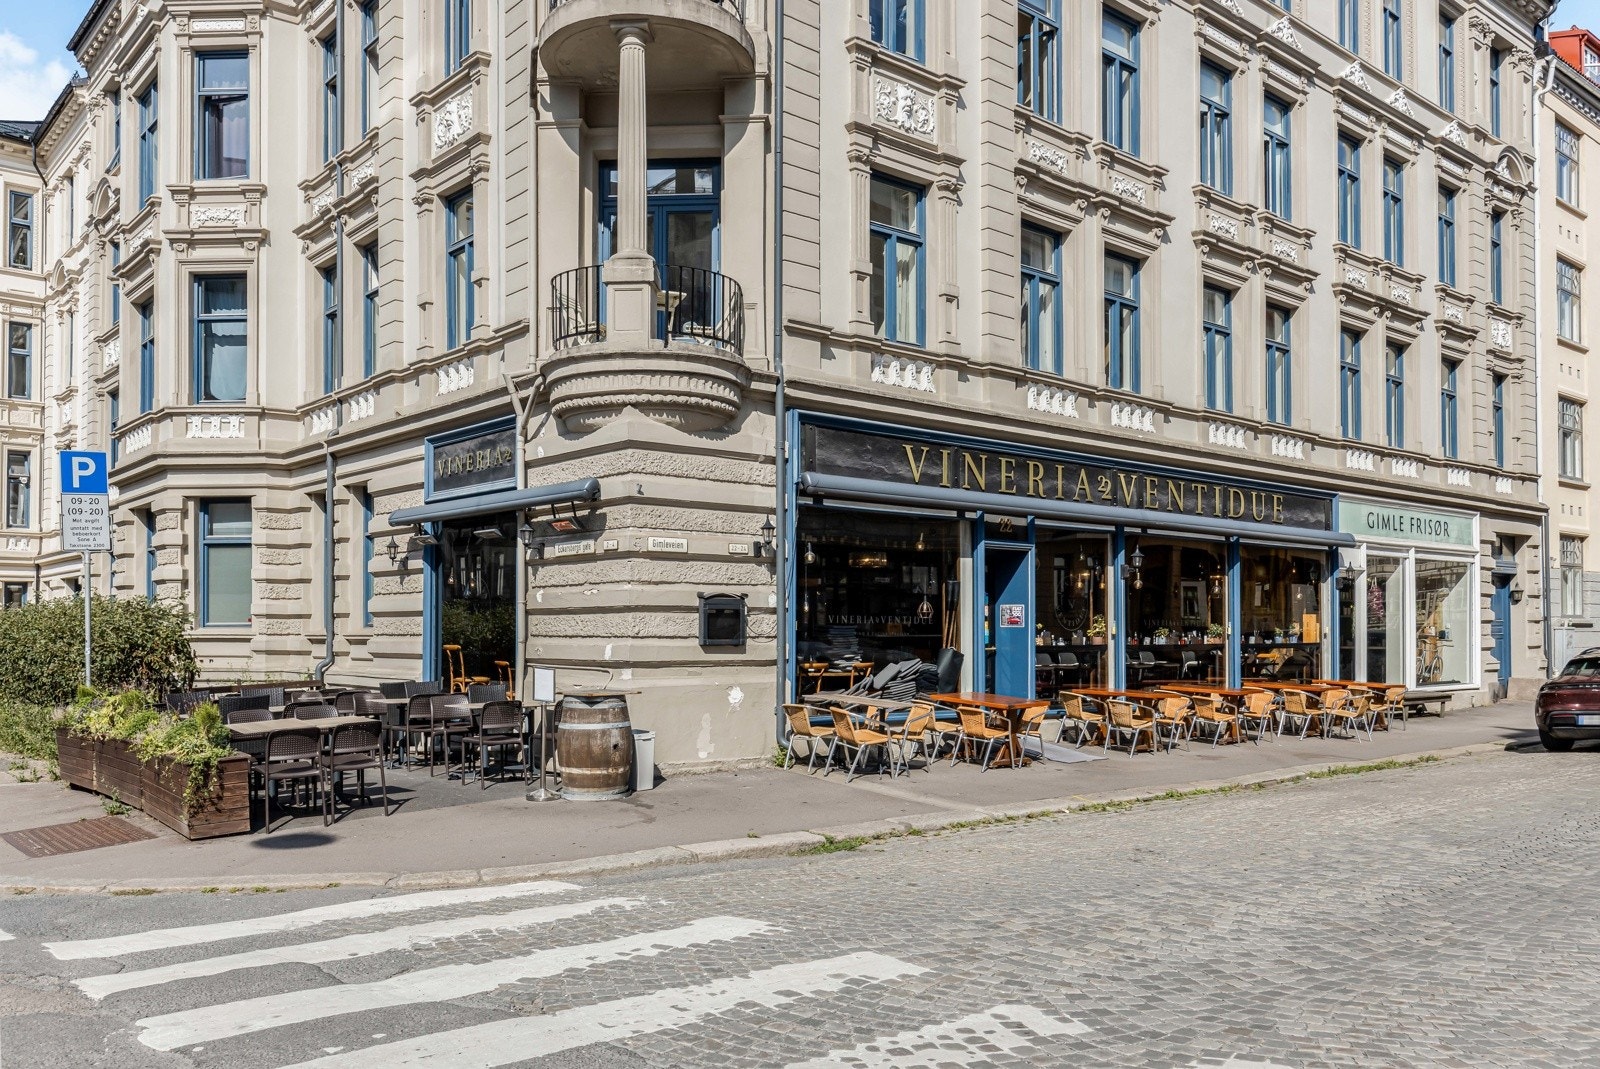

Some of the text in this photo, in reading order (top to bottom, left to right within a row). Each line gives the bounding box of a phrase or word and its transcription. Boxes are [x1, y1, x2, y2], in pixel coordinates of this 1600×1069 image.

[71, 456, 96, 488] P
[438, 446, 503, 477] VINERIA
[902, 444, 1094, 502] VINERIA
[1117, 473, 1285, 523] VENTIDUE
[998, 515, 1013, 533] 22
[1366, 511, 1450, 537] GIMLE FRISØR
[652, 538, 684, 550] Gimleveien
[828, 614, 874, 625] VINERIA
[880, 615, 934, 625] VENTIDUE
